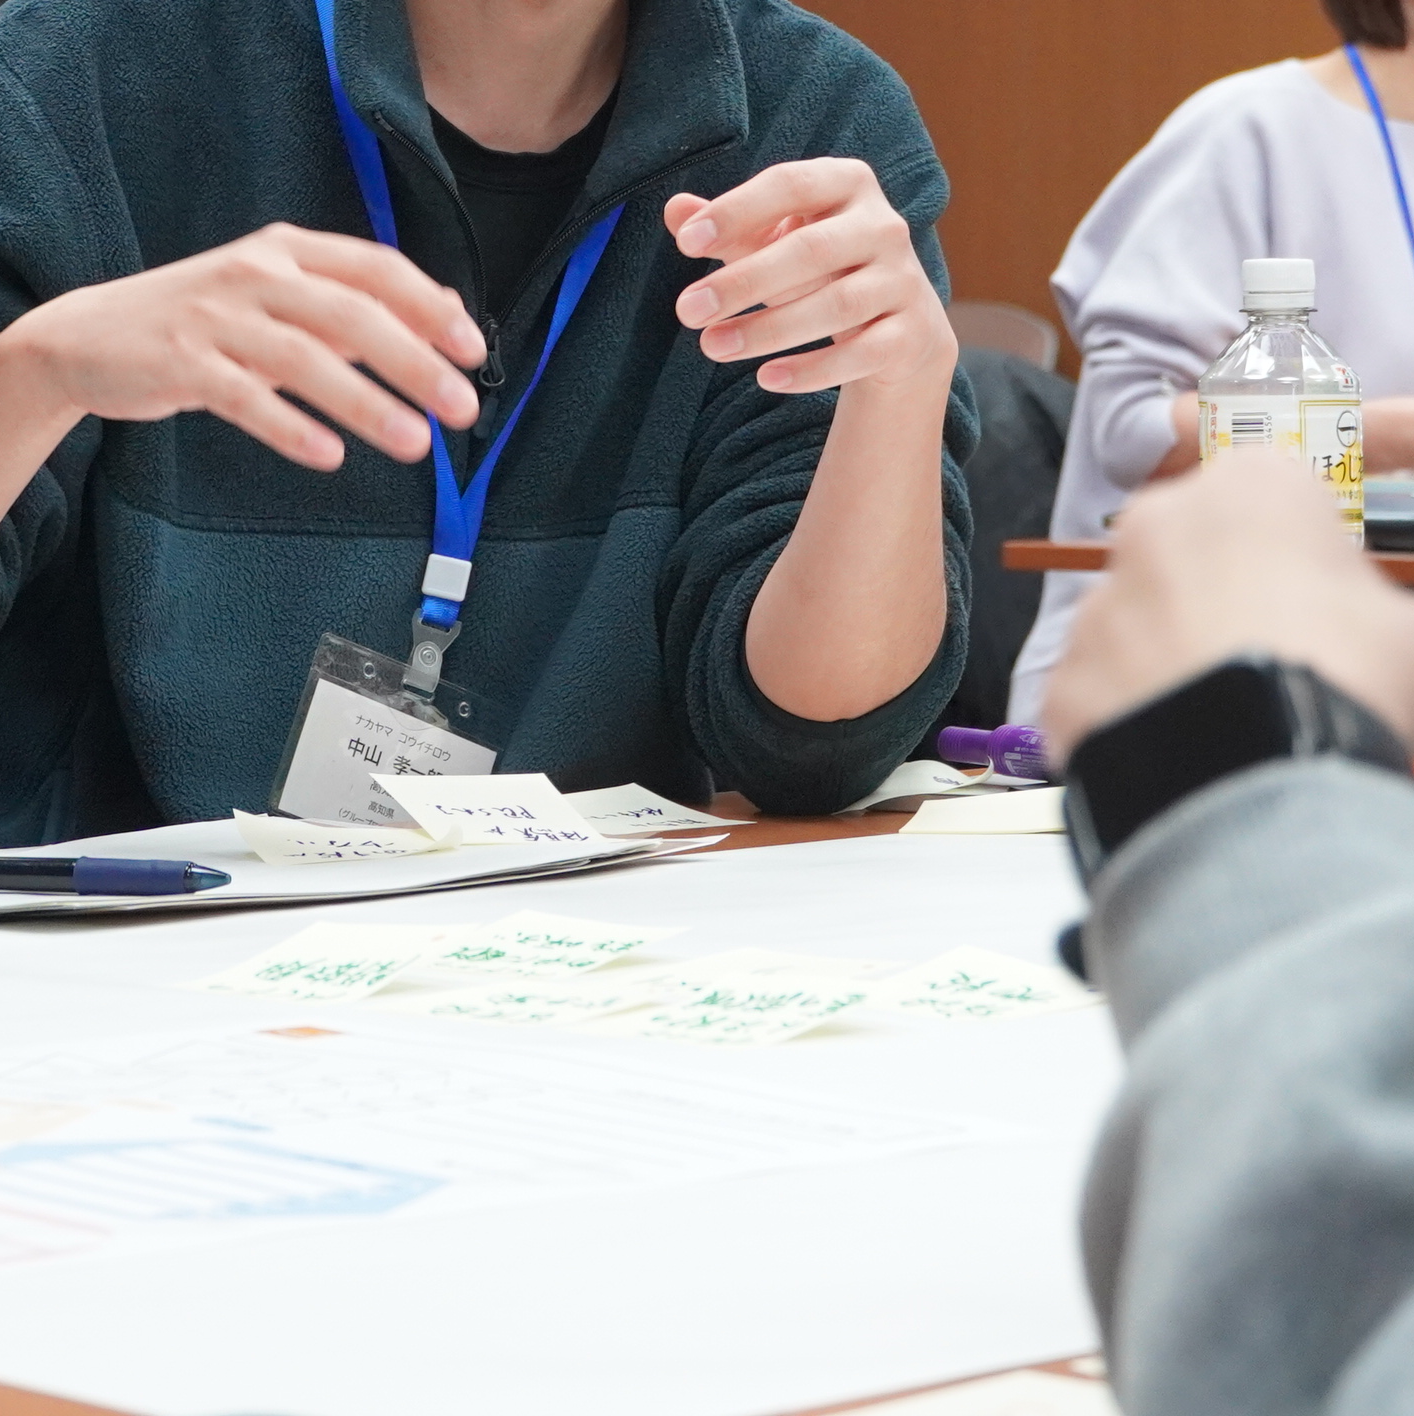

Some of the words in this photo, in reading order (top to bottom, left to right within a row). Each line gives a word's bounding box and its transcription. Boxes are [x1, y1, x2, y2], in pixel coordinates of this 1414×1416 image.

[347, 737, 383, 767] 中山
[355, 714, 394, 737] ナカヤマ
[397, 732, 452, 762] コウイチロウ
[367, 800, 396, 820] 高知県
